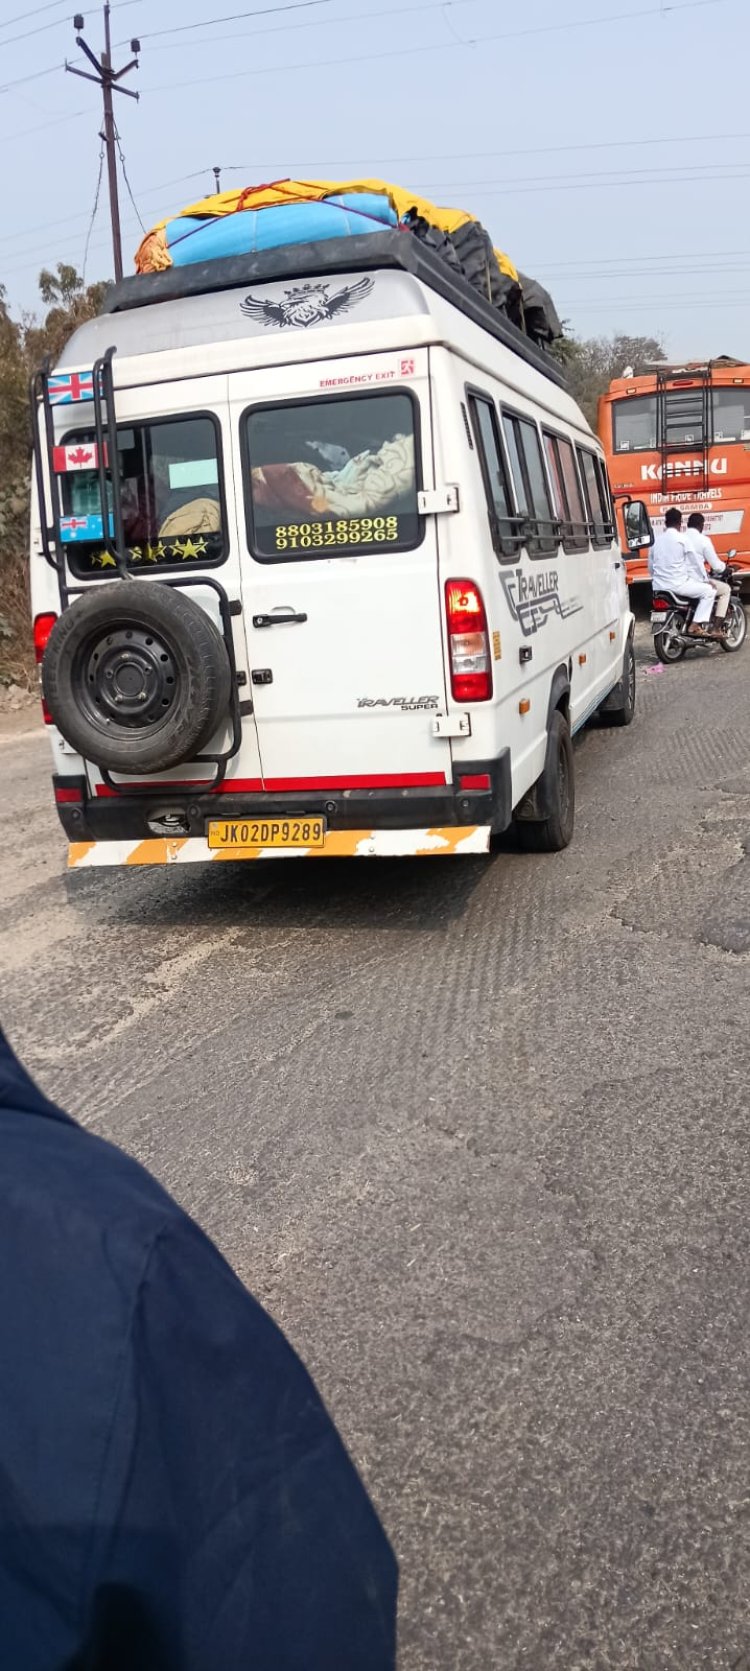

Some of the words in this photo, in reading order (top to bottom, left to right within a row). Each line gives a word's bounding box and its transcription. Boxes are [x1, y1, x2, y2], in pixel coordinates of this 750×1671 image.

[319, 374, 373, 387] EMERGENCY
[375, 371, 396, 380] EXIT
[275, 516, 398, 538] 8803185908
[275, 527, 399, 550] 9103299265
[515, 568, 559, 602] TRAVELLER
[357, 695, 440, 708] TRAVELLER
[401, 703, 439, 711] SUPER
[220, 822, 321, 843] JK02DP9289
